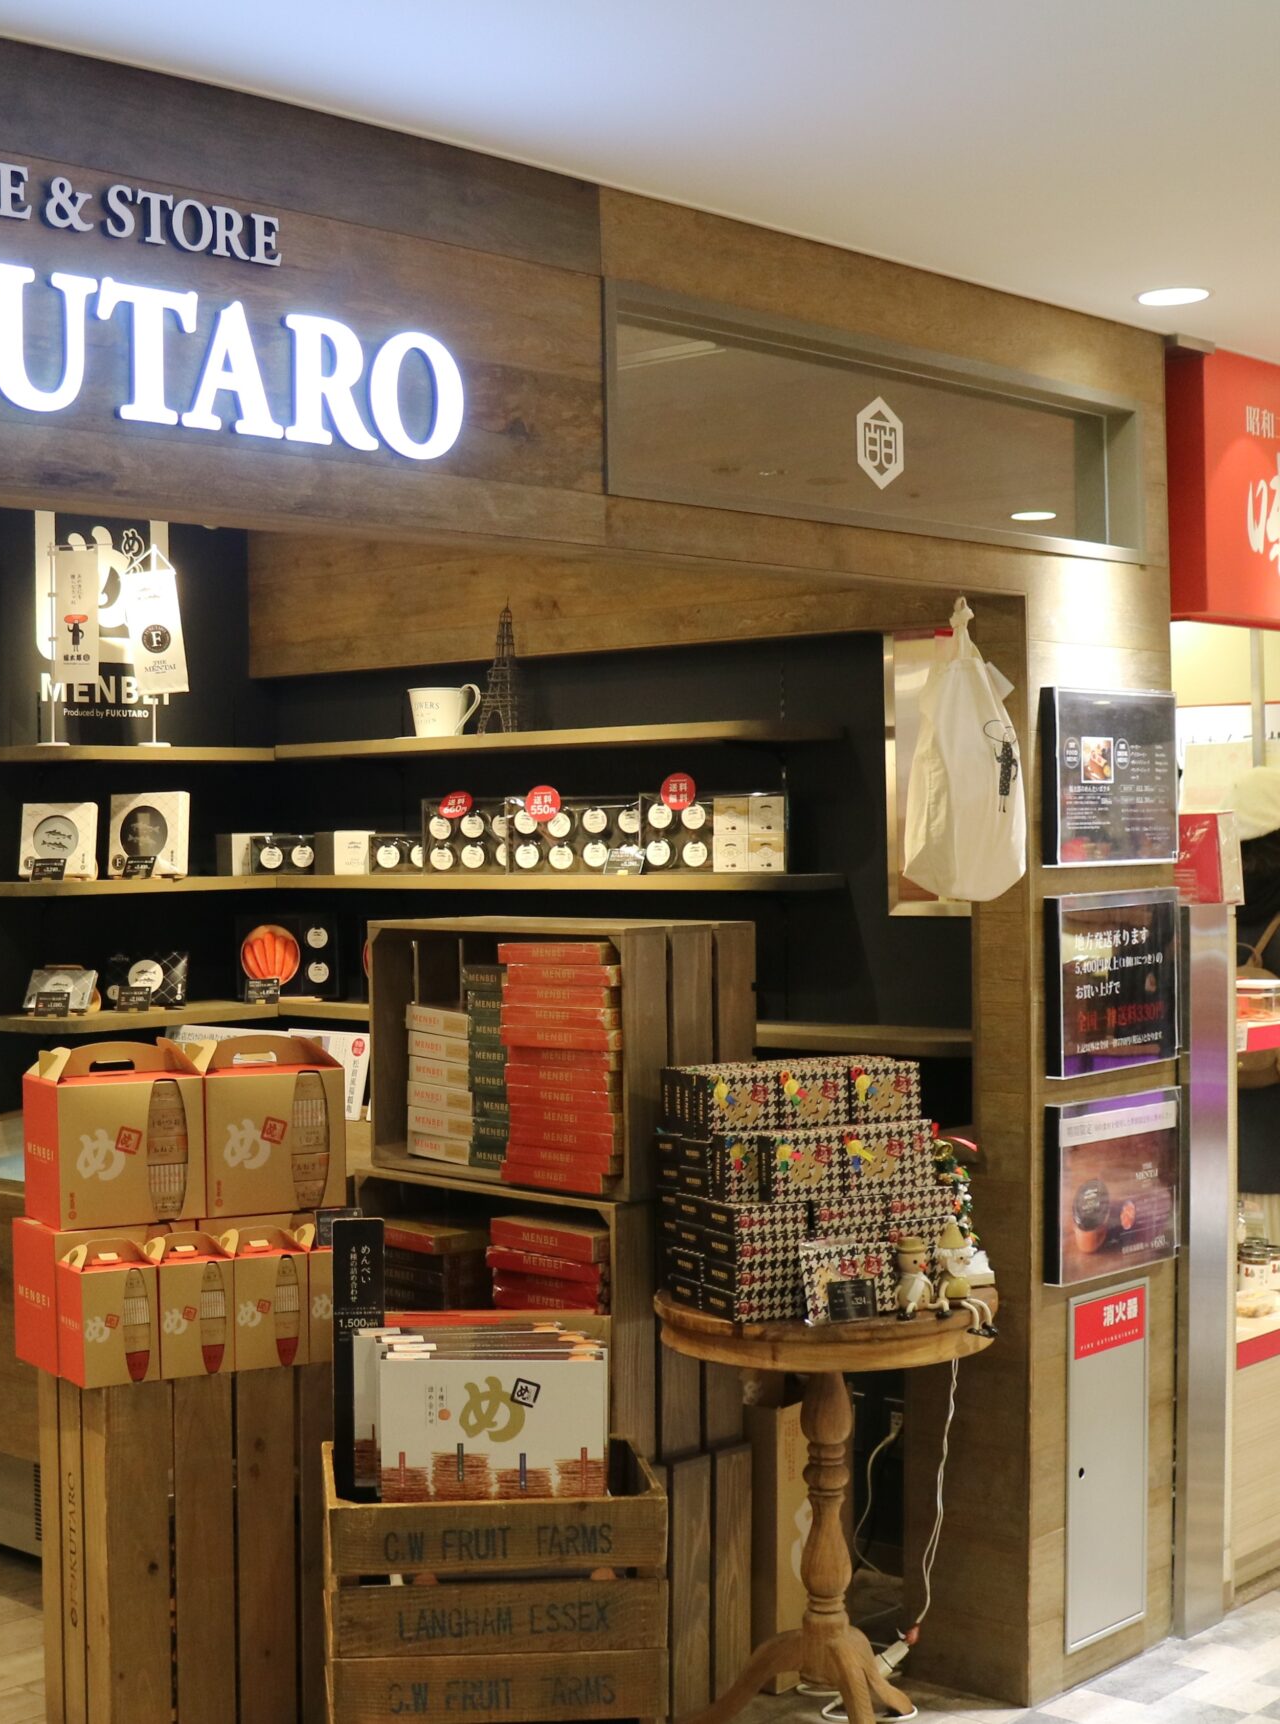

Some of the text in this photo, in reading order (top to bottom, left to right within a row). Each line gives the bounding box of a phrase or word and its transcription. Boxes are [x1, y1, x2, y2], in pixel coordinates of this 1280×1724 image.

[45, 176, 94, 233] &
[105, 184, 283, 268] STORE
[144, 664, 177, 674] MENTAI
[63, 707, 150, 719] Produced by FUKUTARO
[442, 805, 468, 814] 660円
[530, 804, 556, 815] 550円
[533, 796, 552, 805] 送料
[1074, 927, 1148, 951] 地方発送承ります
[1075, 981, 1120, 1000] お買い上げで
[27, 1142, 54, 1162] MENBEI
[77, 1128, 126, 1182] め
[223, 1118, 272, 1170] め
[521, 1231, 558, 1246] MENBEI
[360, 1244, 371, 1285] めんべい
[523, 1255, 564, 1270] MENBEI
[18, 1285, 51, 1308] MENBEI
[162, 1308, 189, 1335] め
[237, 1300, 262, 1328] め
[1103, 1296, 1138, 1327] 消火器
[85, 1316, 110, 1343] め
[459, 1376, 526, 1443] め
[440, 1525, 512, 1561] FRUIT
[537, 1523, 613, 1556] FARMS
[398, 1601, 613, 1643] LANGHAM ESSEX
